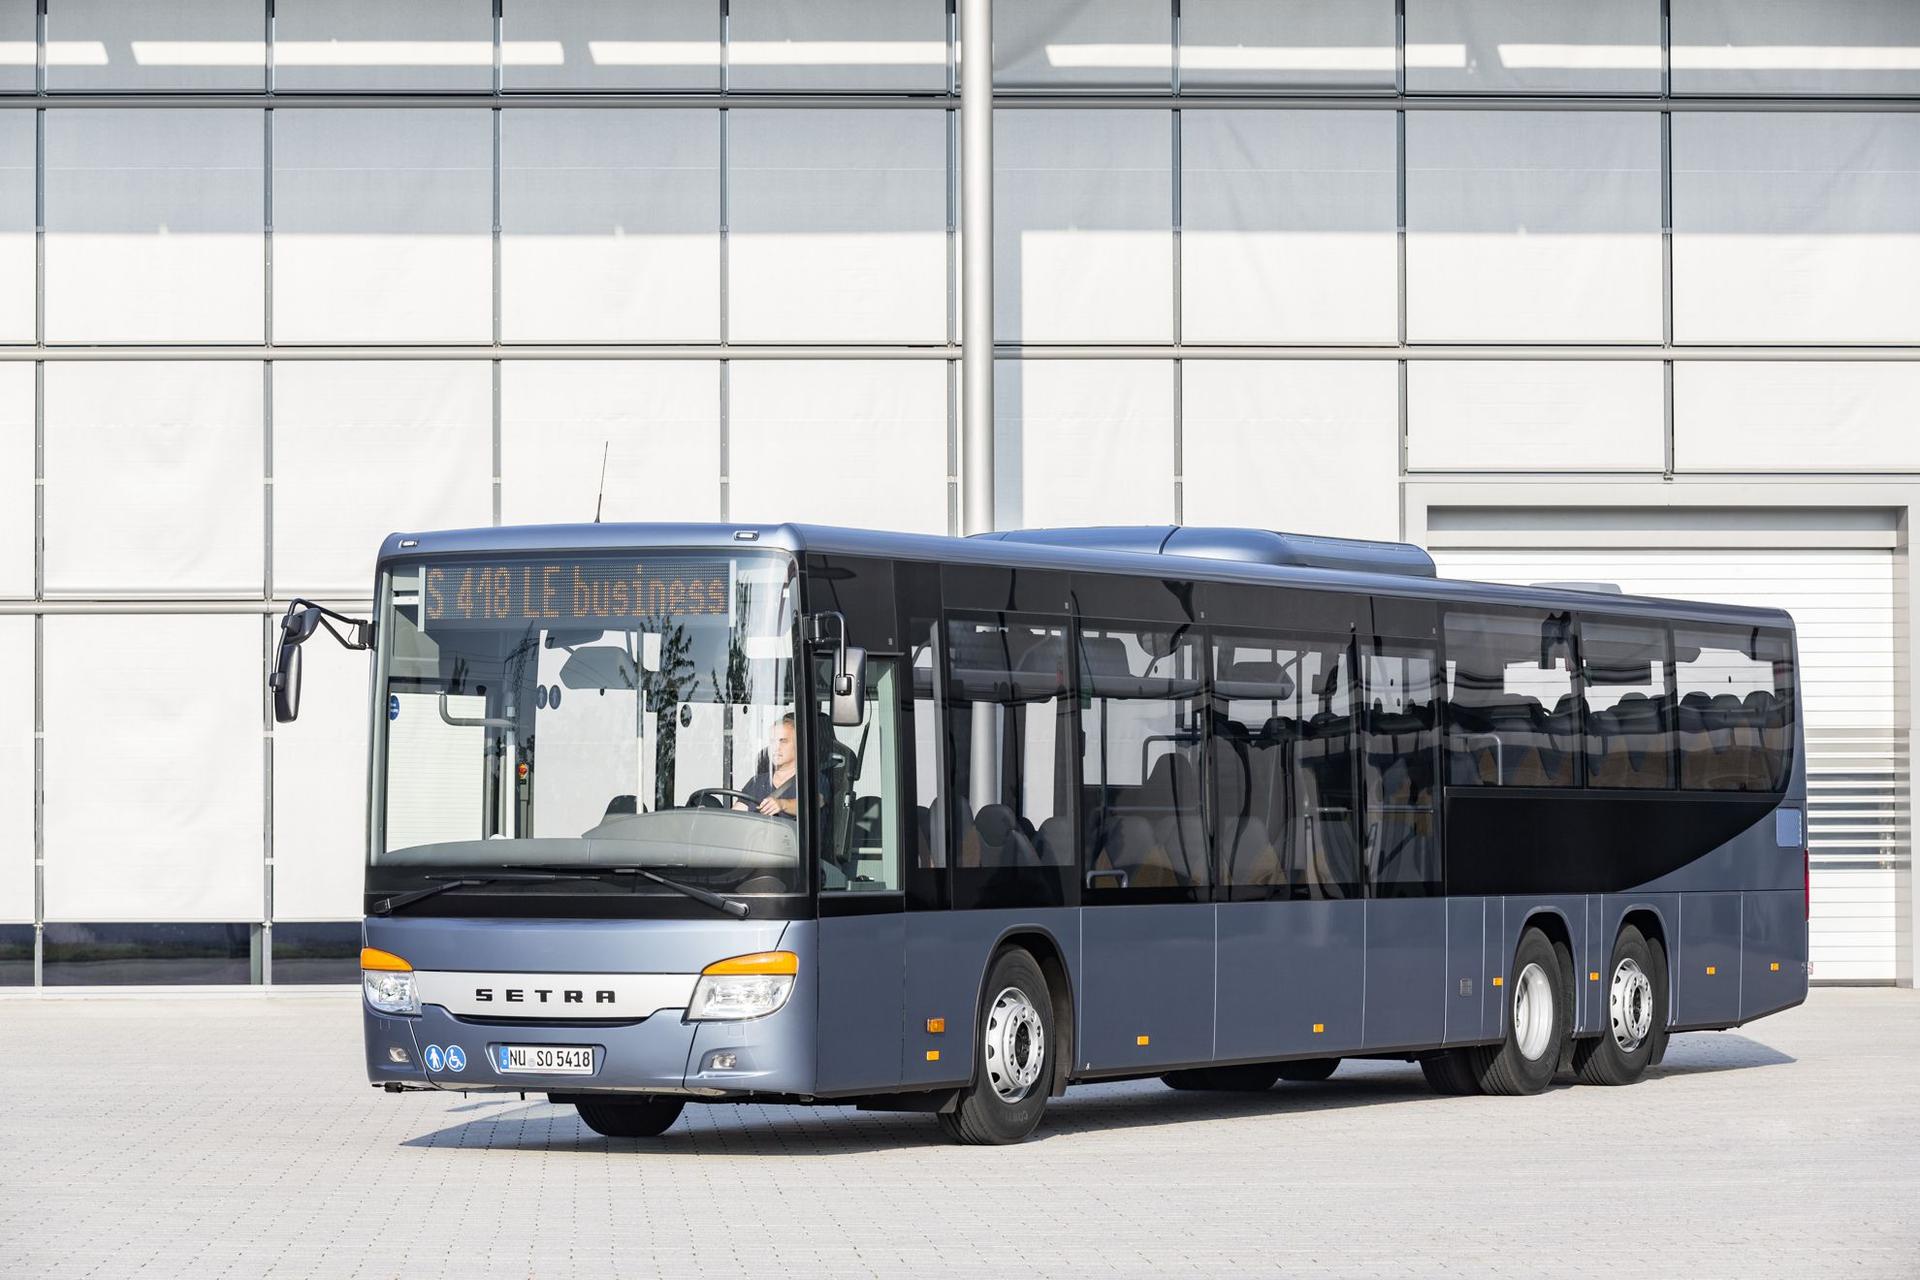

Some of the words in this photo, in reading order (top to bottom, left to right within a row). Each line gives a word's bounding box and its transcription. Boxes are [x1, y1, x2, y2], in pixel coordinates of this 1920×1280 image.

[427, 568, 445, 619] S
[457, 567, 511, 619] 418
[523, 566, 561, 618] LE
[572, 564, 725, 617] business
[475, 988, 616, 1004] SETRA
[509, 1049, 526, 1066] NU
[536, 1050, 553, 1067] SO
[556, 1051, 590, 1068] 5418
